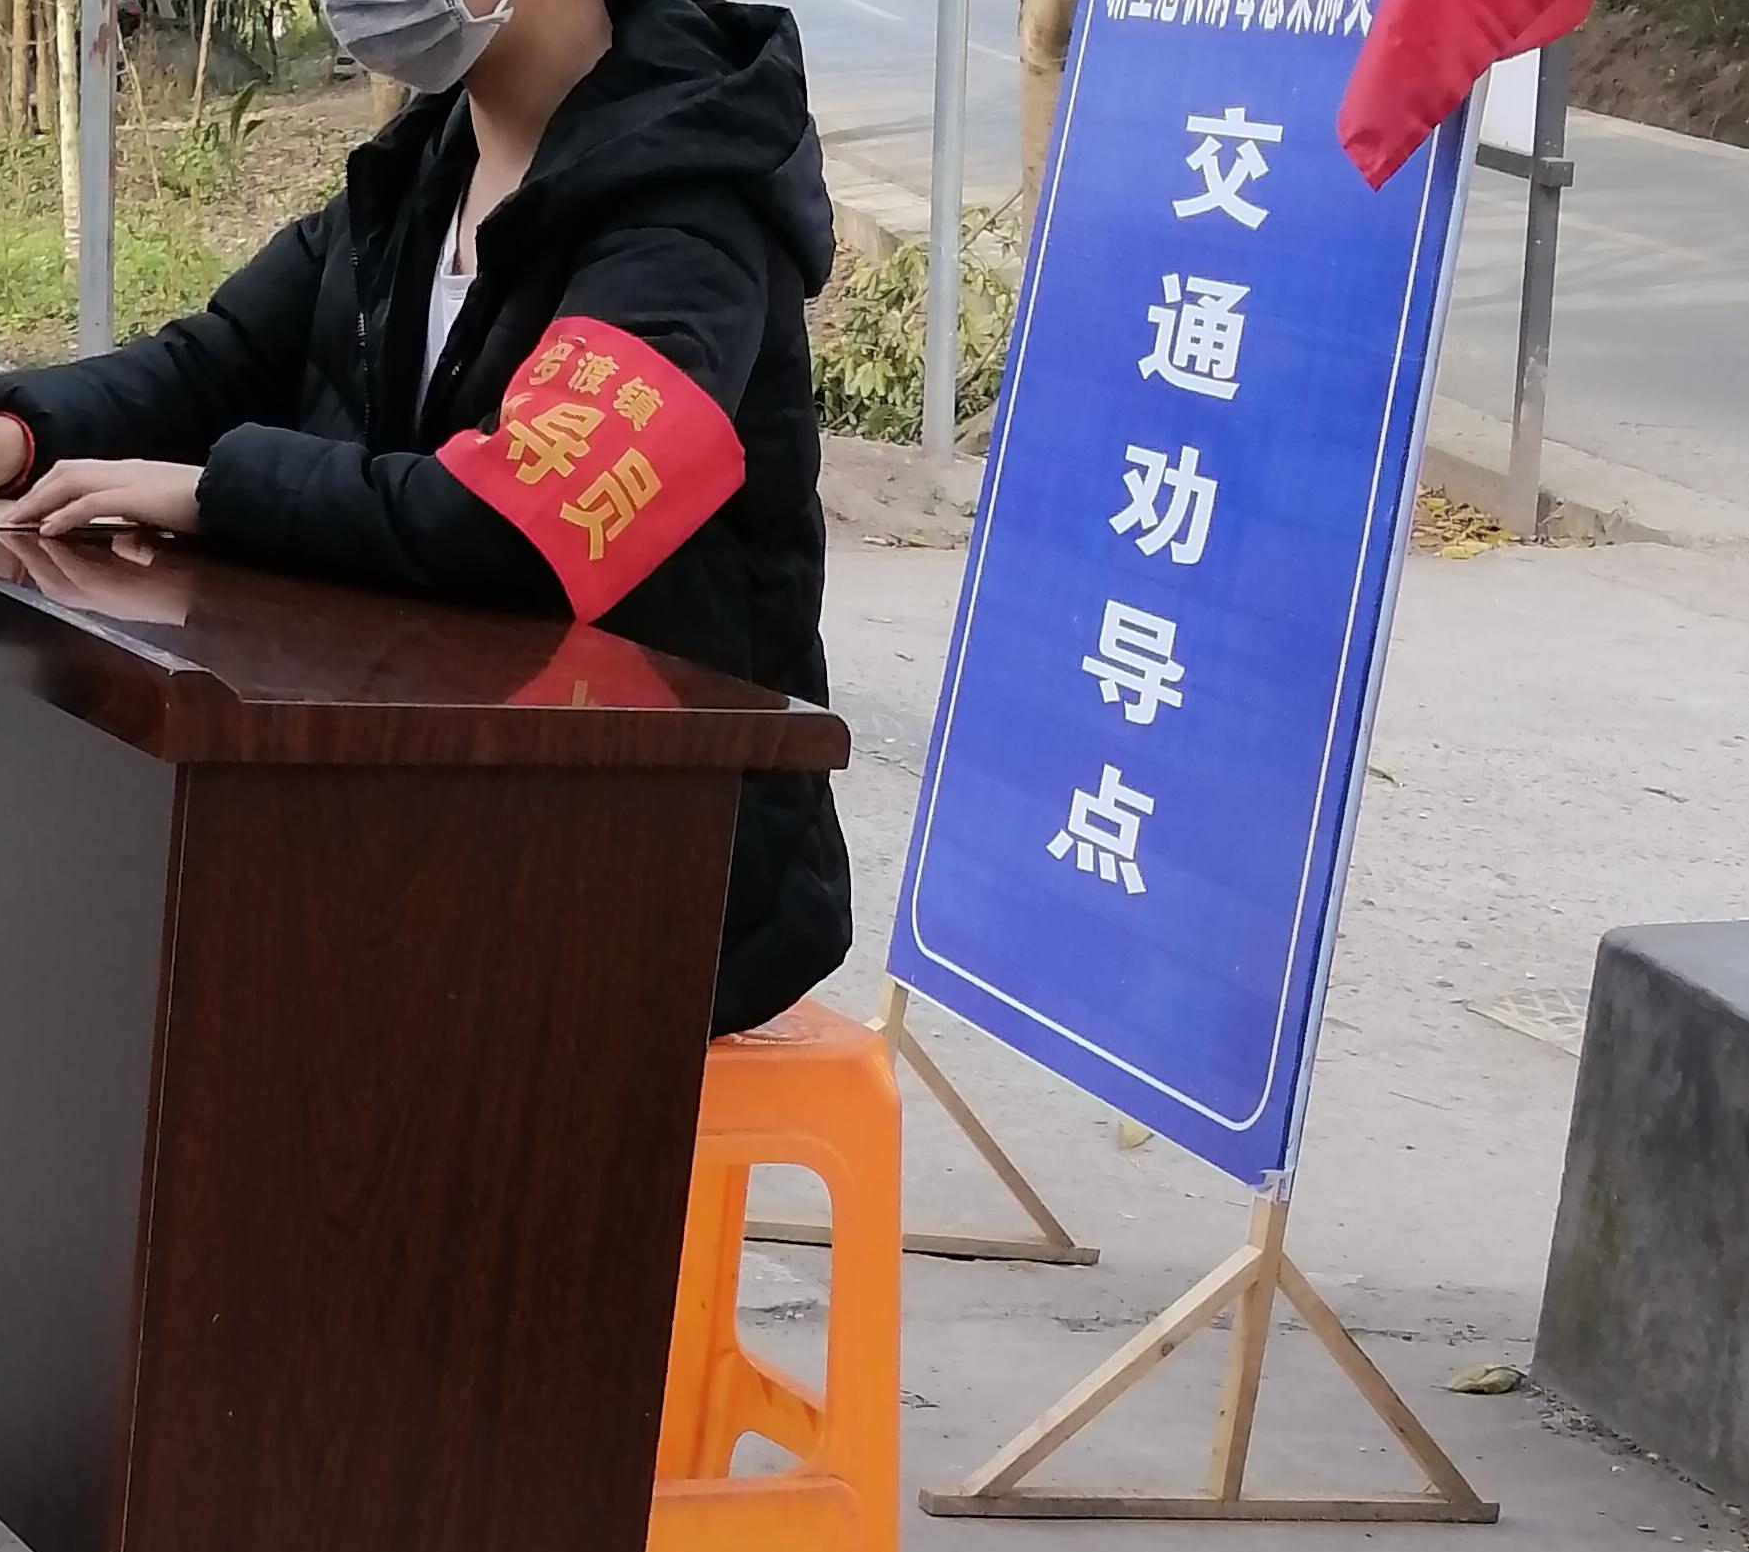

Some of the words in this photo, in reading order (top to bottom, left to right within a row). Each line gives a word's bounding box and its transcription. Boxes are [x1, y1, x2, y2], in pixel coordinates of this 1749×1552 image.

[528, 335, 664, 432] 罗渡镇
[502, 391, 663, 561] 导员
[1045, 106, 1284, 896] 交通劝导点
